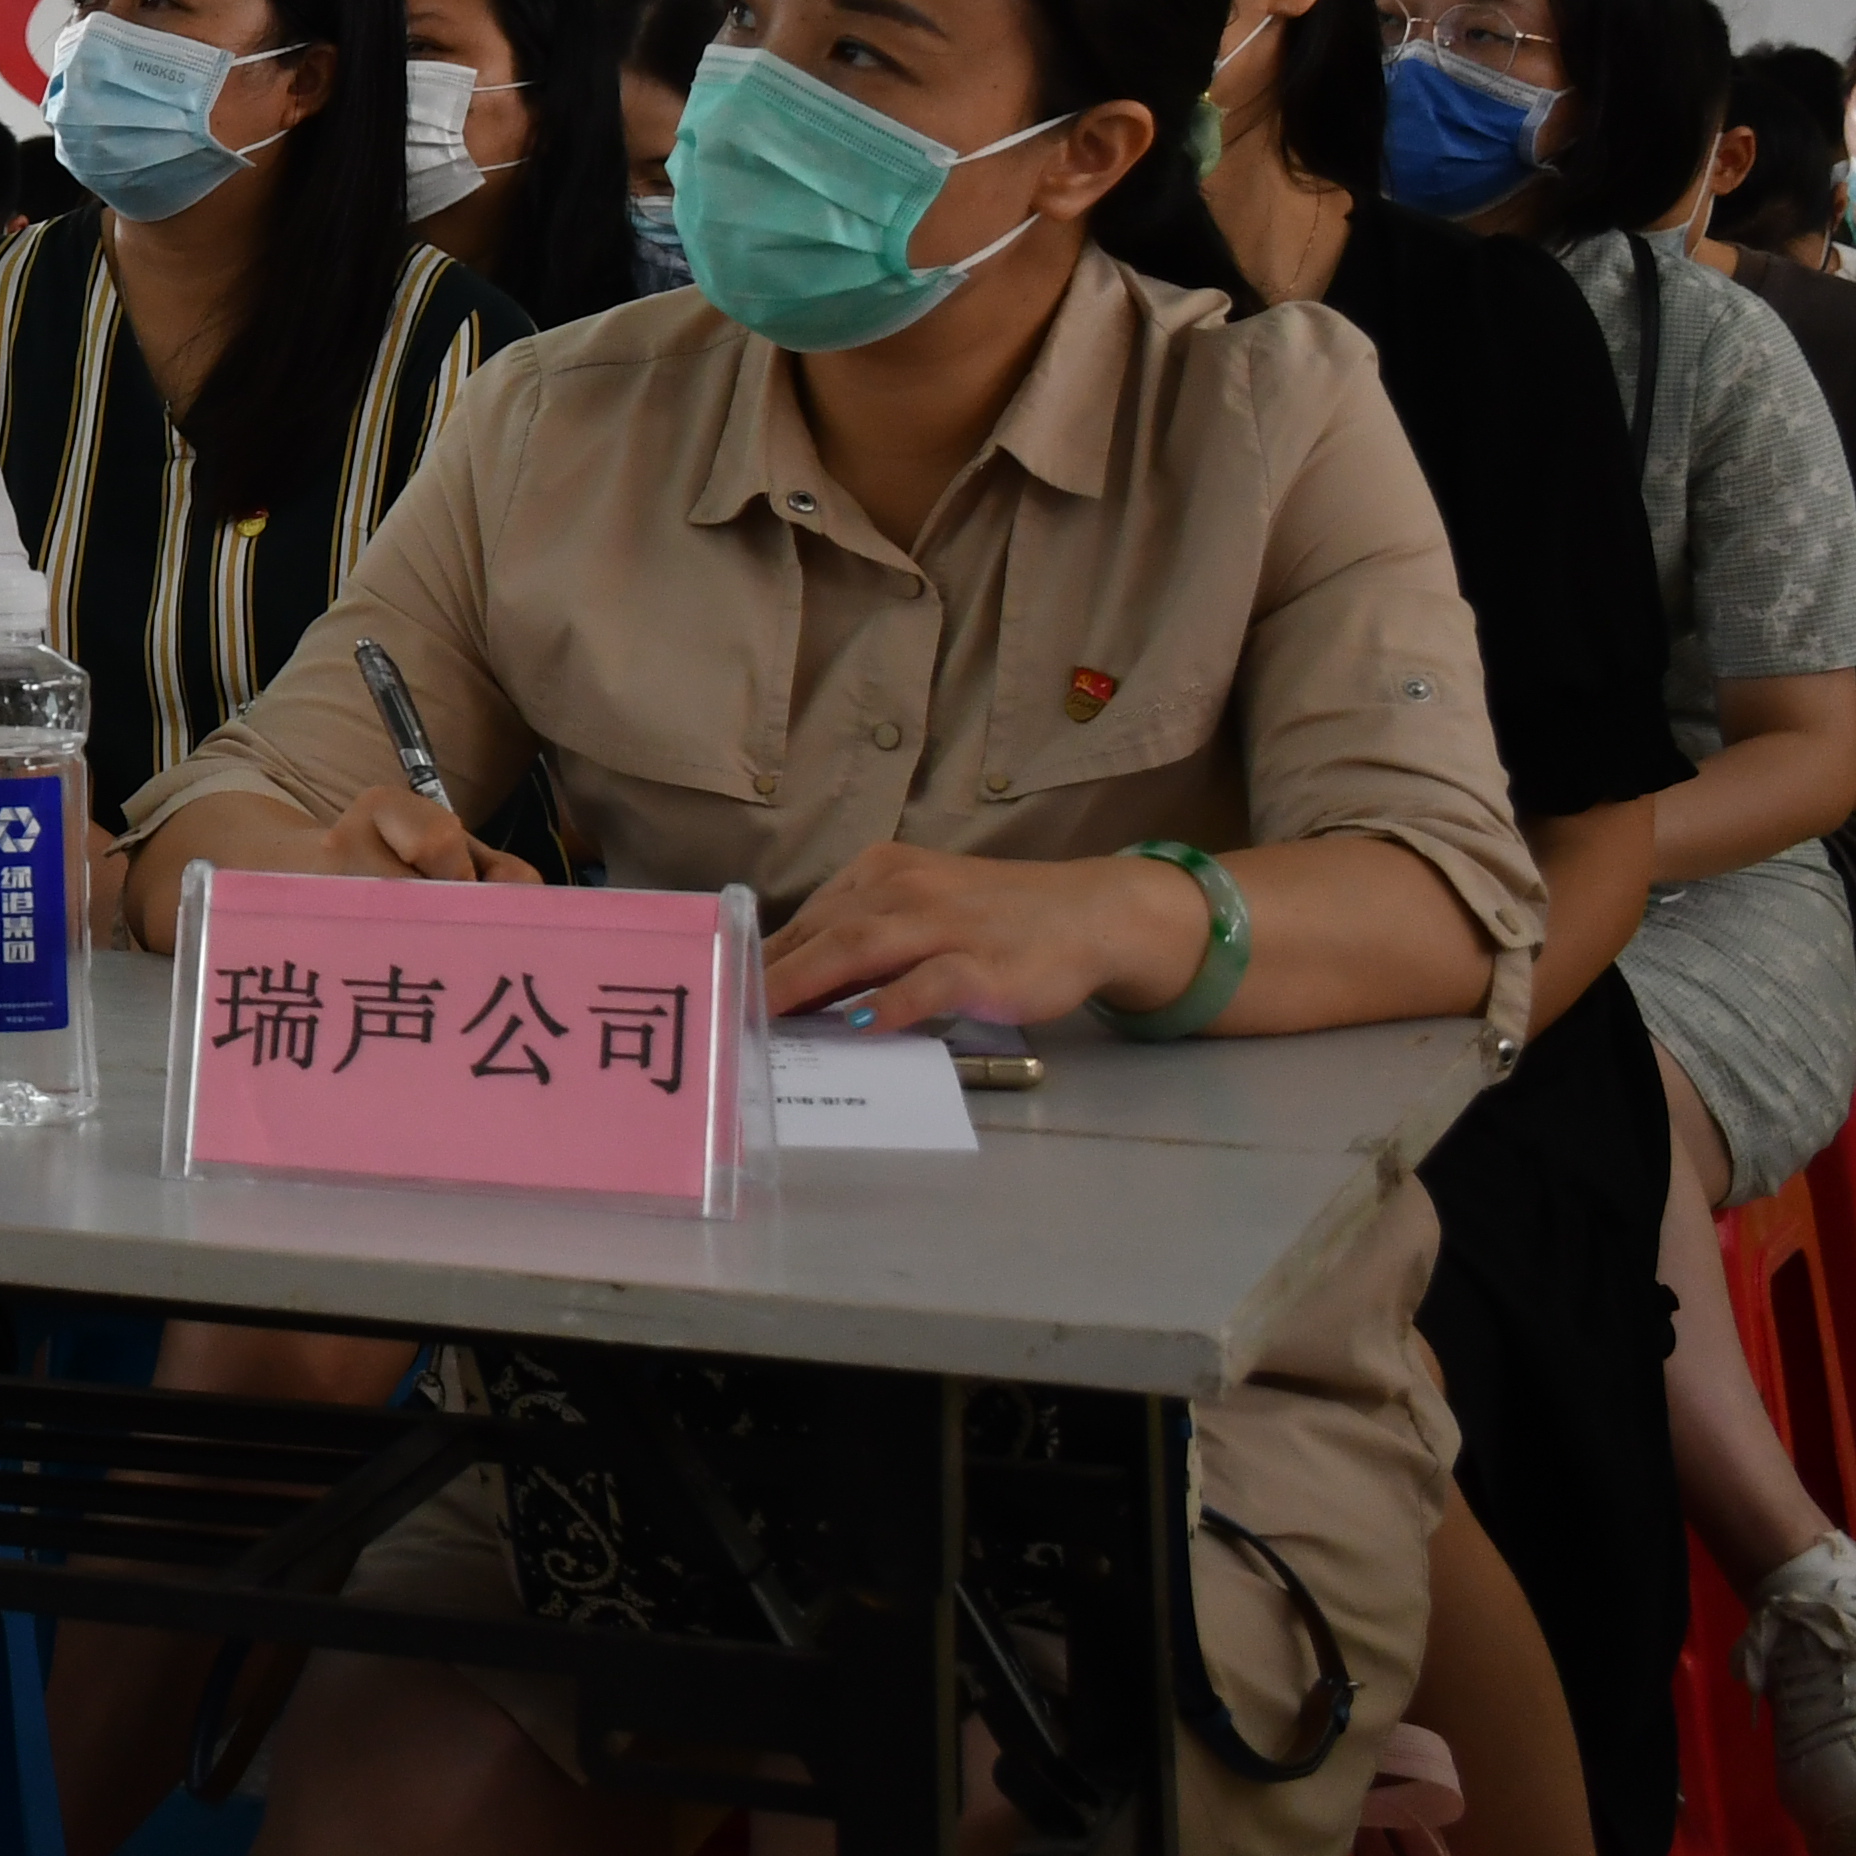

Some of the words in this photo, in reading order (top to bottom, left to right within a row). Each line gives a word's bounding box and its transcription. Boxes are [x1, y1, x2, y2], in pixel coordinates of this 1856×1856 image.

[133, 59, 186, 85] HNSKSS
[210, 959, 691, 1095] 瑞声公司
